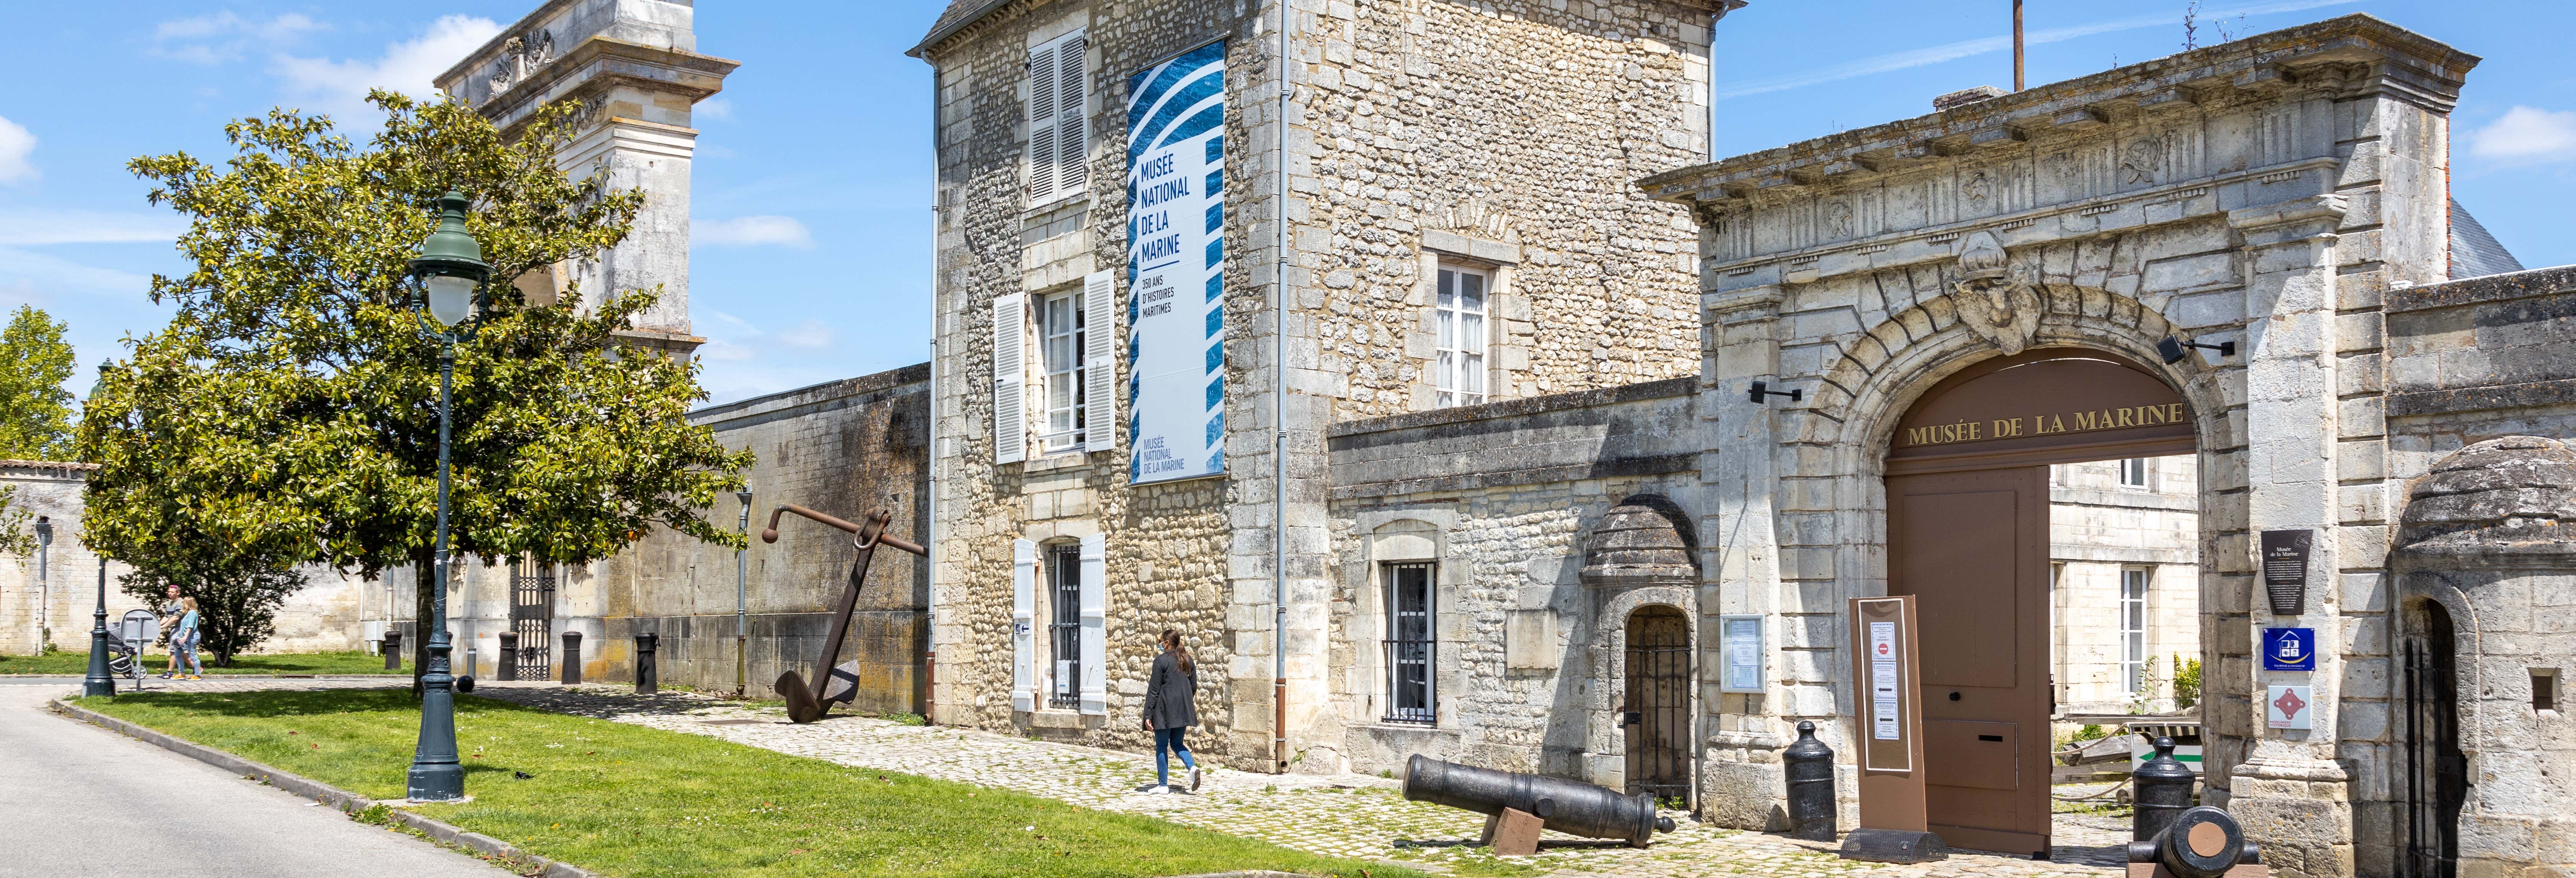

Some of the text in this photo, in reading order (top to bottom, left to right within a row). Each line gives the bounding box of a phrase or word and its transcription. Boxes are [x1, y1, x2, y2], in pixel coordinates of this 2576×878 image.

[1141, 150, 1173, 182] MUSÉE
[1142, 176, 1190, 209] NATIONAL
[1142, 210, 1168, 236] DE LA
[1142, 233, 1180, 263] MARINE
[1142, 275, 1163, 290] 350 ANS
[1143, 287, 1174, 304] D'HISTOIRES
[1143, 302, 1171, 318] MARITIMES
[1907, 403, 2183, 445] MUSÉE DE LA MARINE
[1144, 435, 1164, 450] MUSÉE
[1144, 448, 1172, 462] NATIONAL
[1144, 458, 1184, 474] DE LA MARINE
